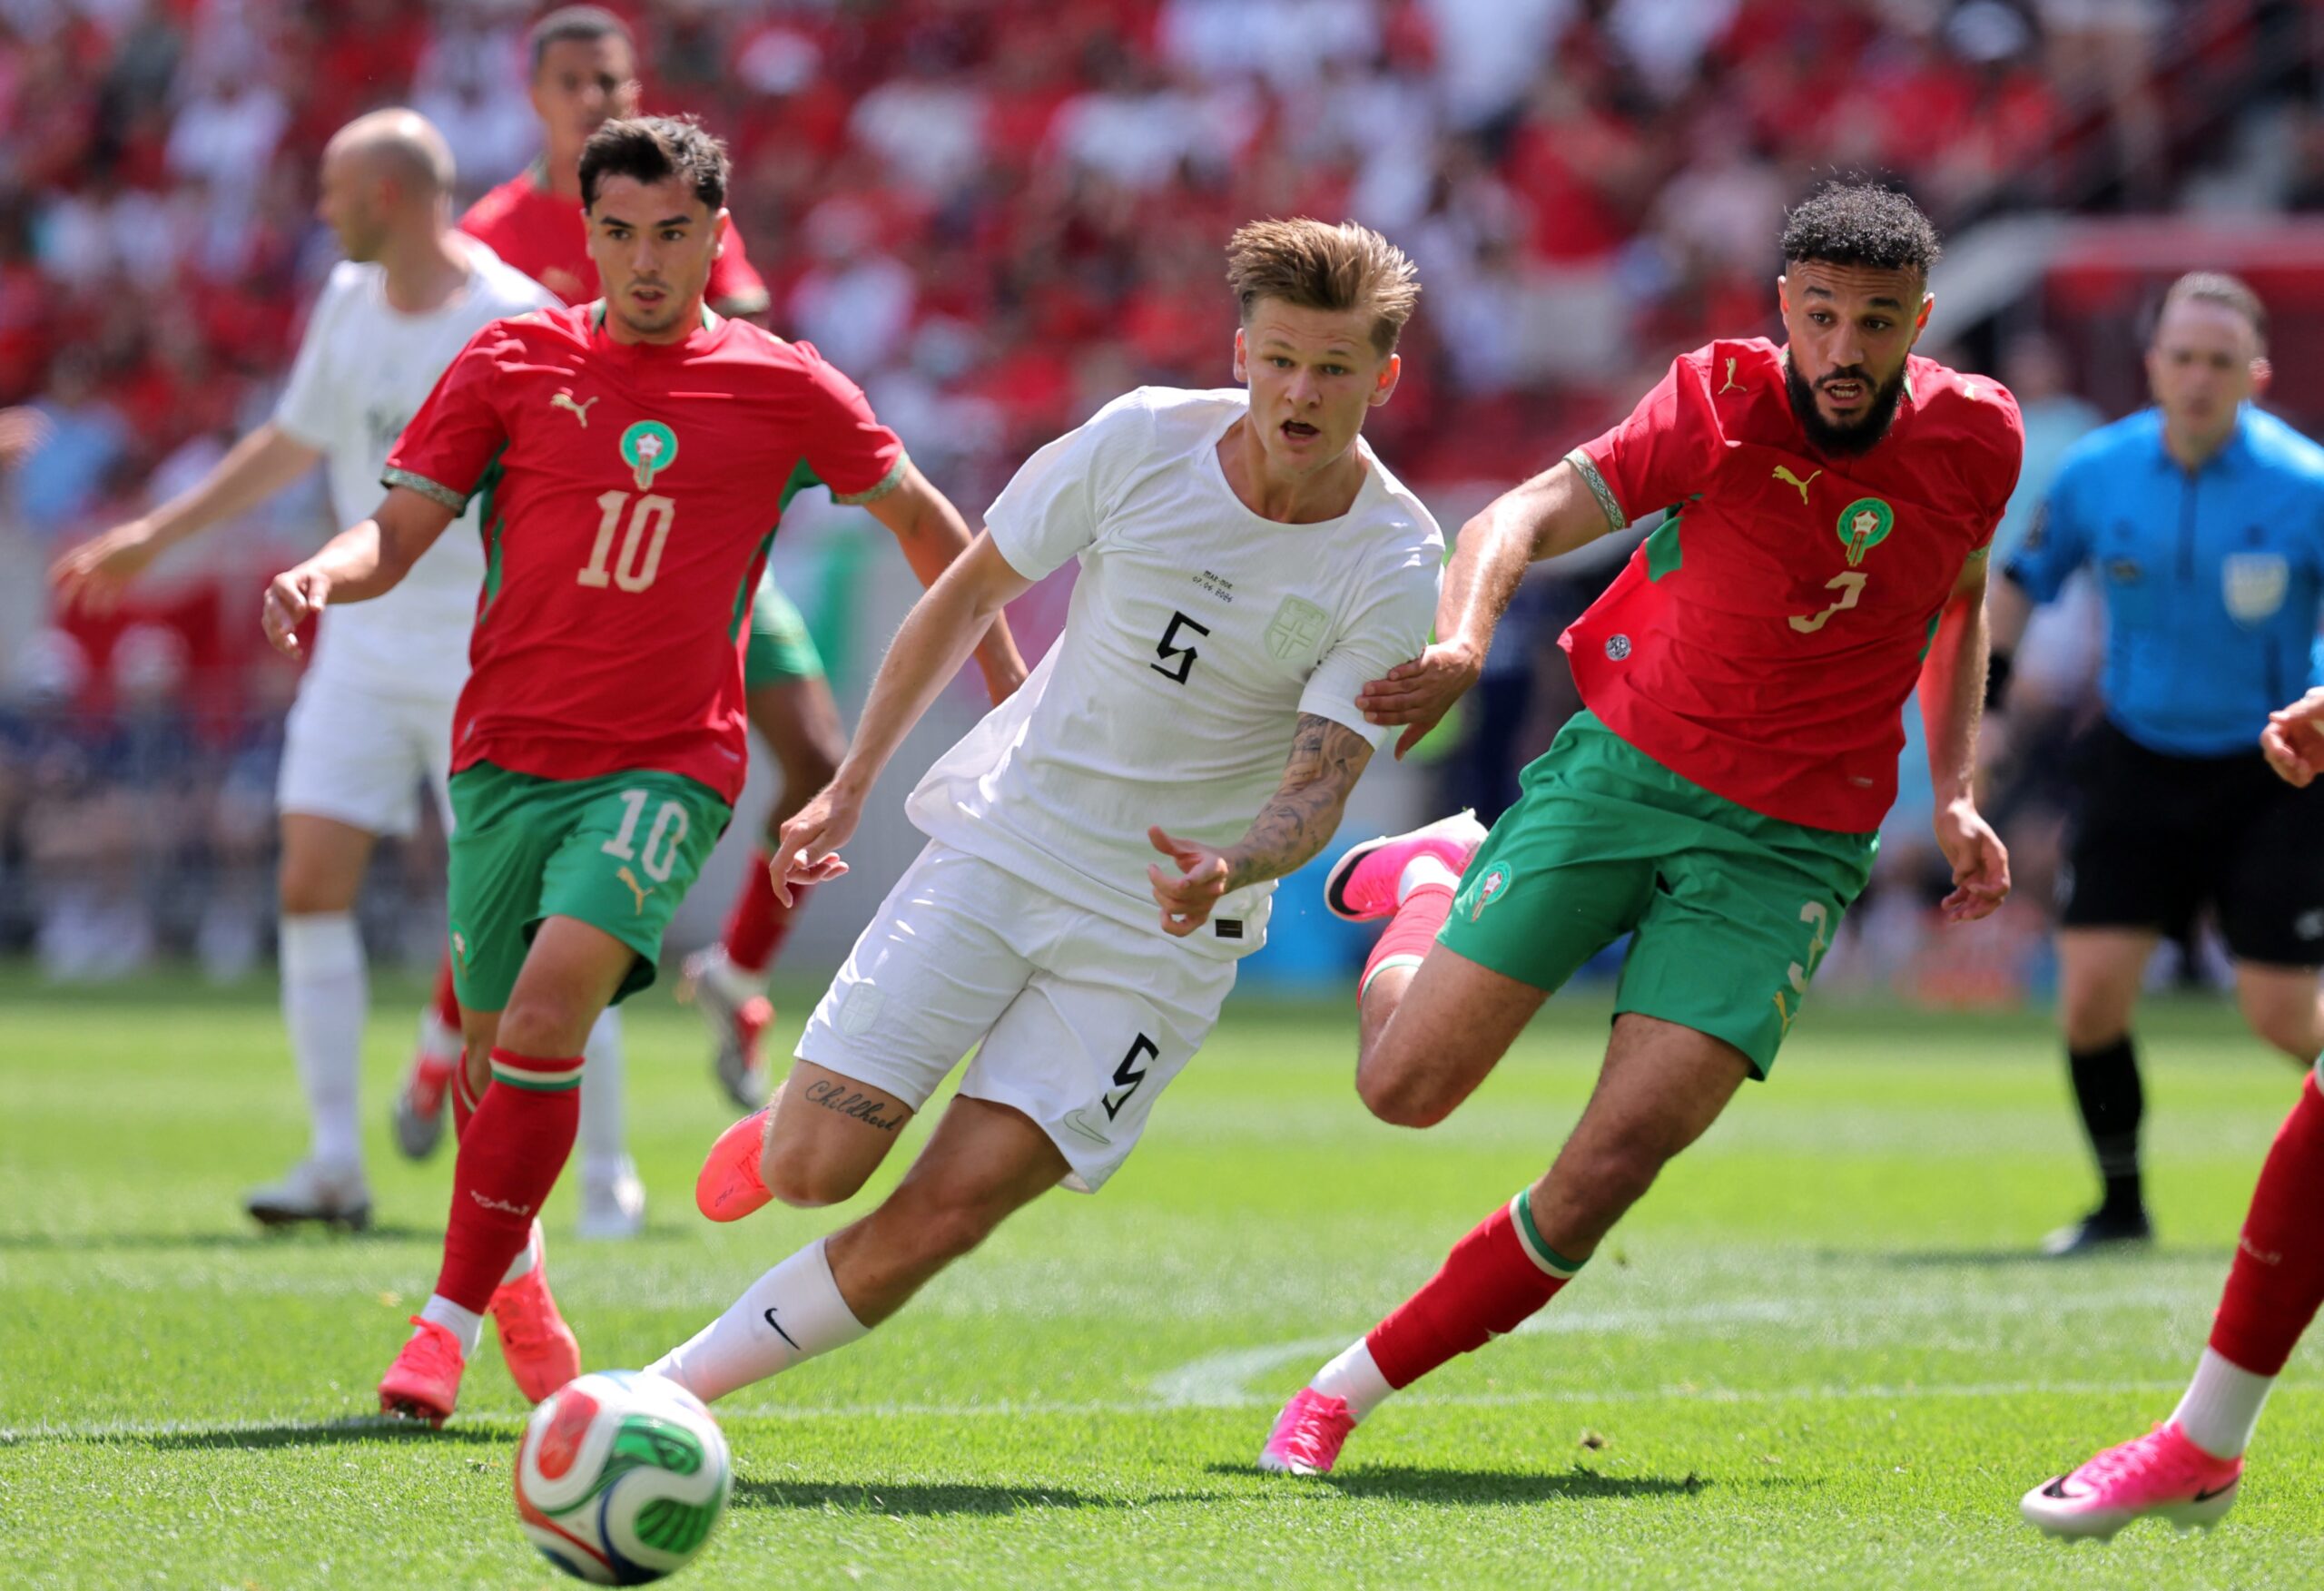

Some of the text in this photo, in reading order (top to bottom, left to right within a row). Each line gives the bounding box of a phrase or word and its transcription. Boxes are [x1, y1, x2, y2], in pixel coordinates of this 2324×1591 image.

[576, 489, 676, 594] 10
[1149, 610, 1211, 685] 5
[600, 788, 689, 883] 10
[1787, 899, 1829, 995] 3
[804, 1080, 903, 1131] Childhood
[1101, 1031, 1160, 1123] 5
